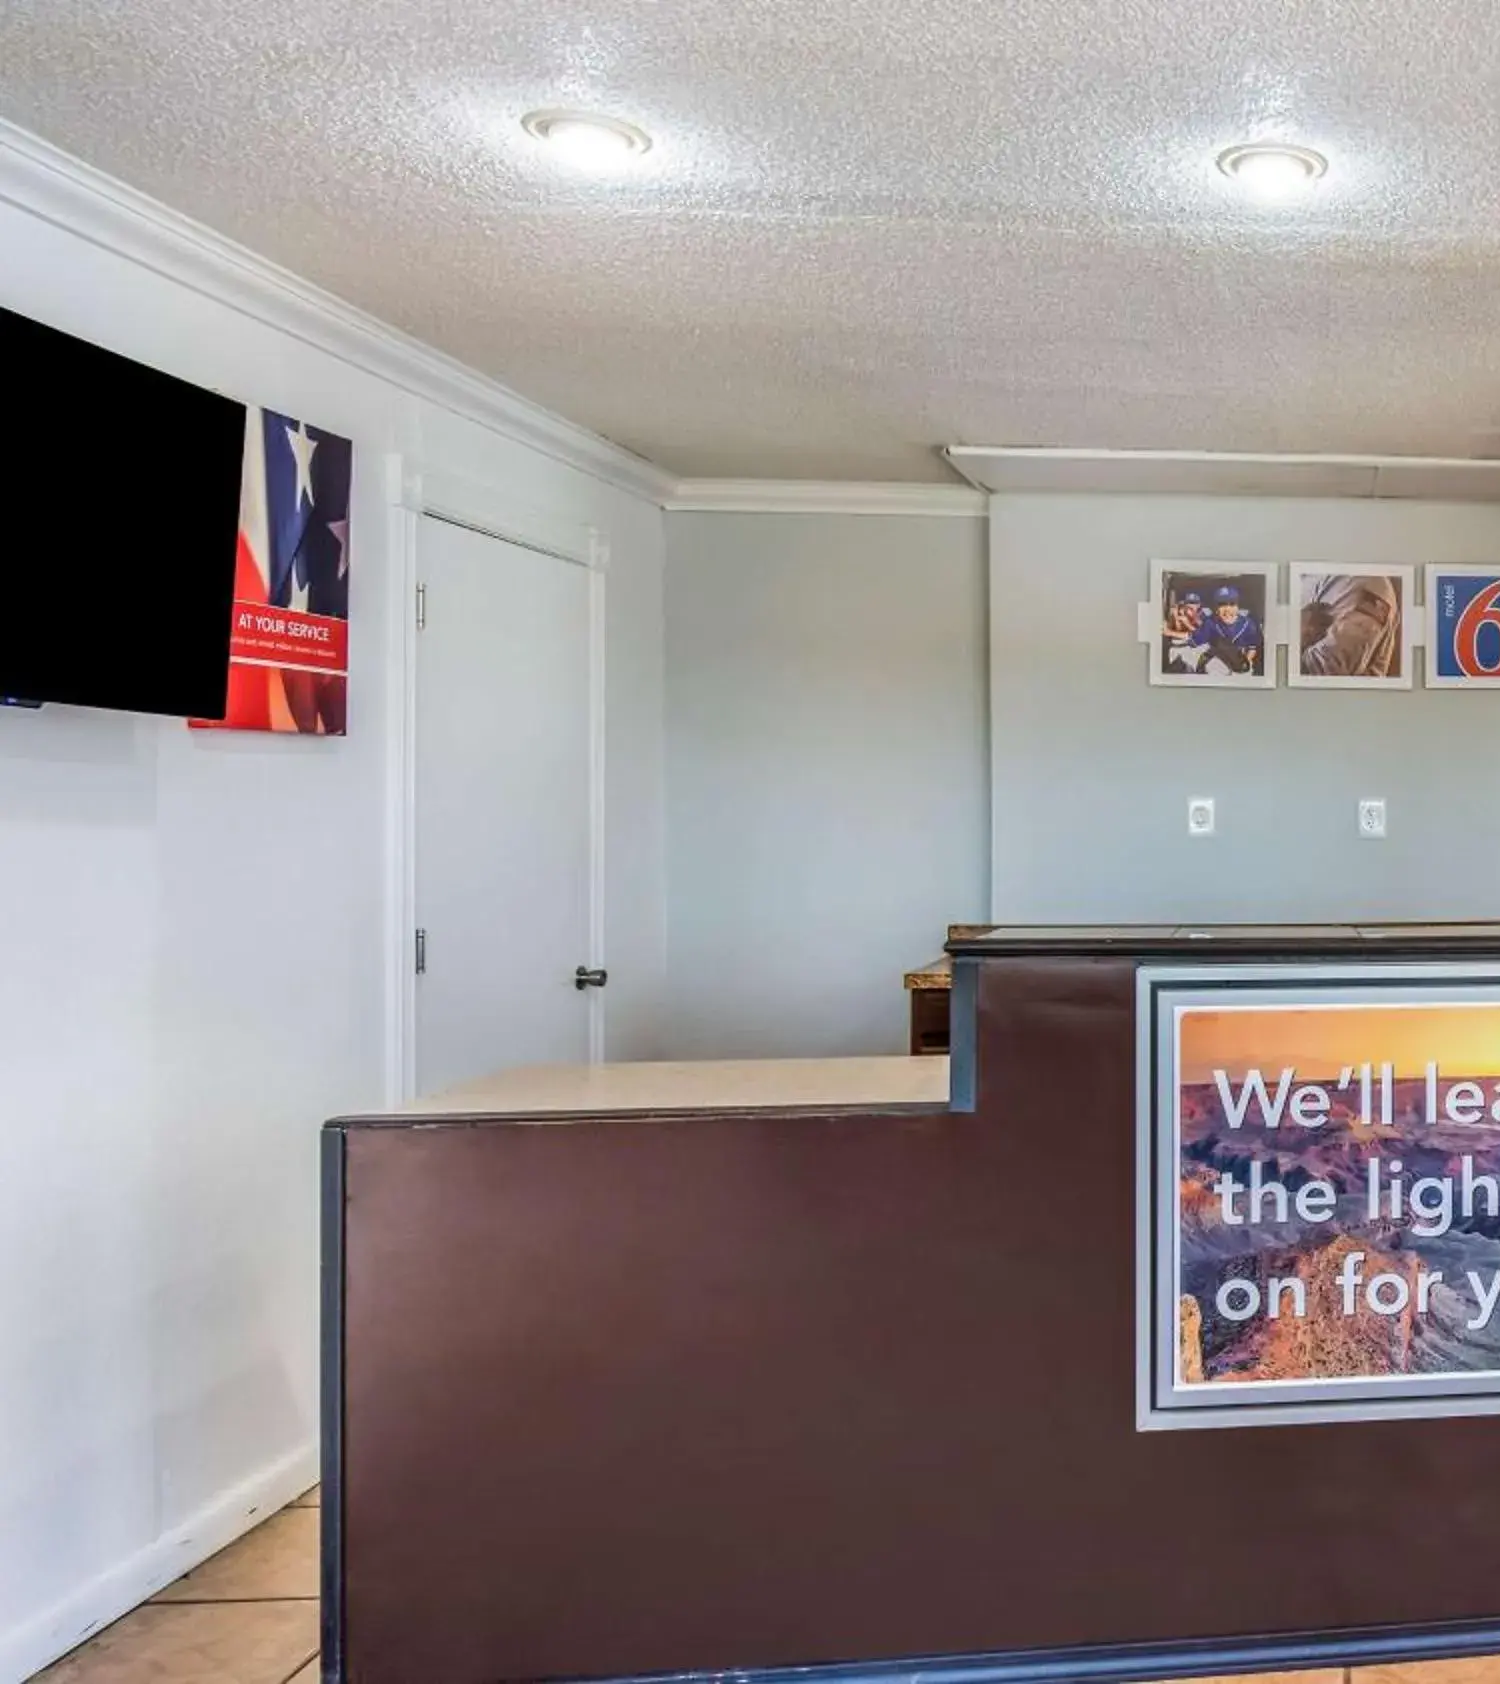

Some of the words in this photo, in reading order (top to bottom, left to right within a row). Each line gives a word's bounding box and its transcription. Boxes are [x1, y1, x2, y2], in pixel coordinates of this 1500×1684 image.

[1443, 584, 1455, 617] motel
[239, 613, 253, 629] AT
[255, 616, 286, 634] YOUR
[287, 621, 330, 641] SERVICE
[1214, 1160, 1337, 1225] the
[1214, 1273, 1306, 1322] on
[1335, 1252, 1443, 1316] for
